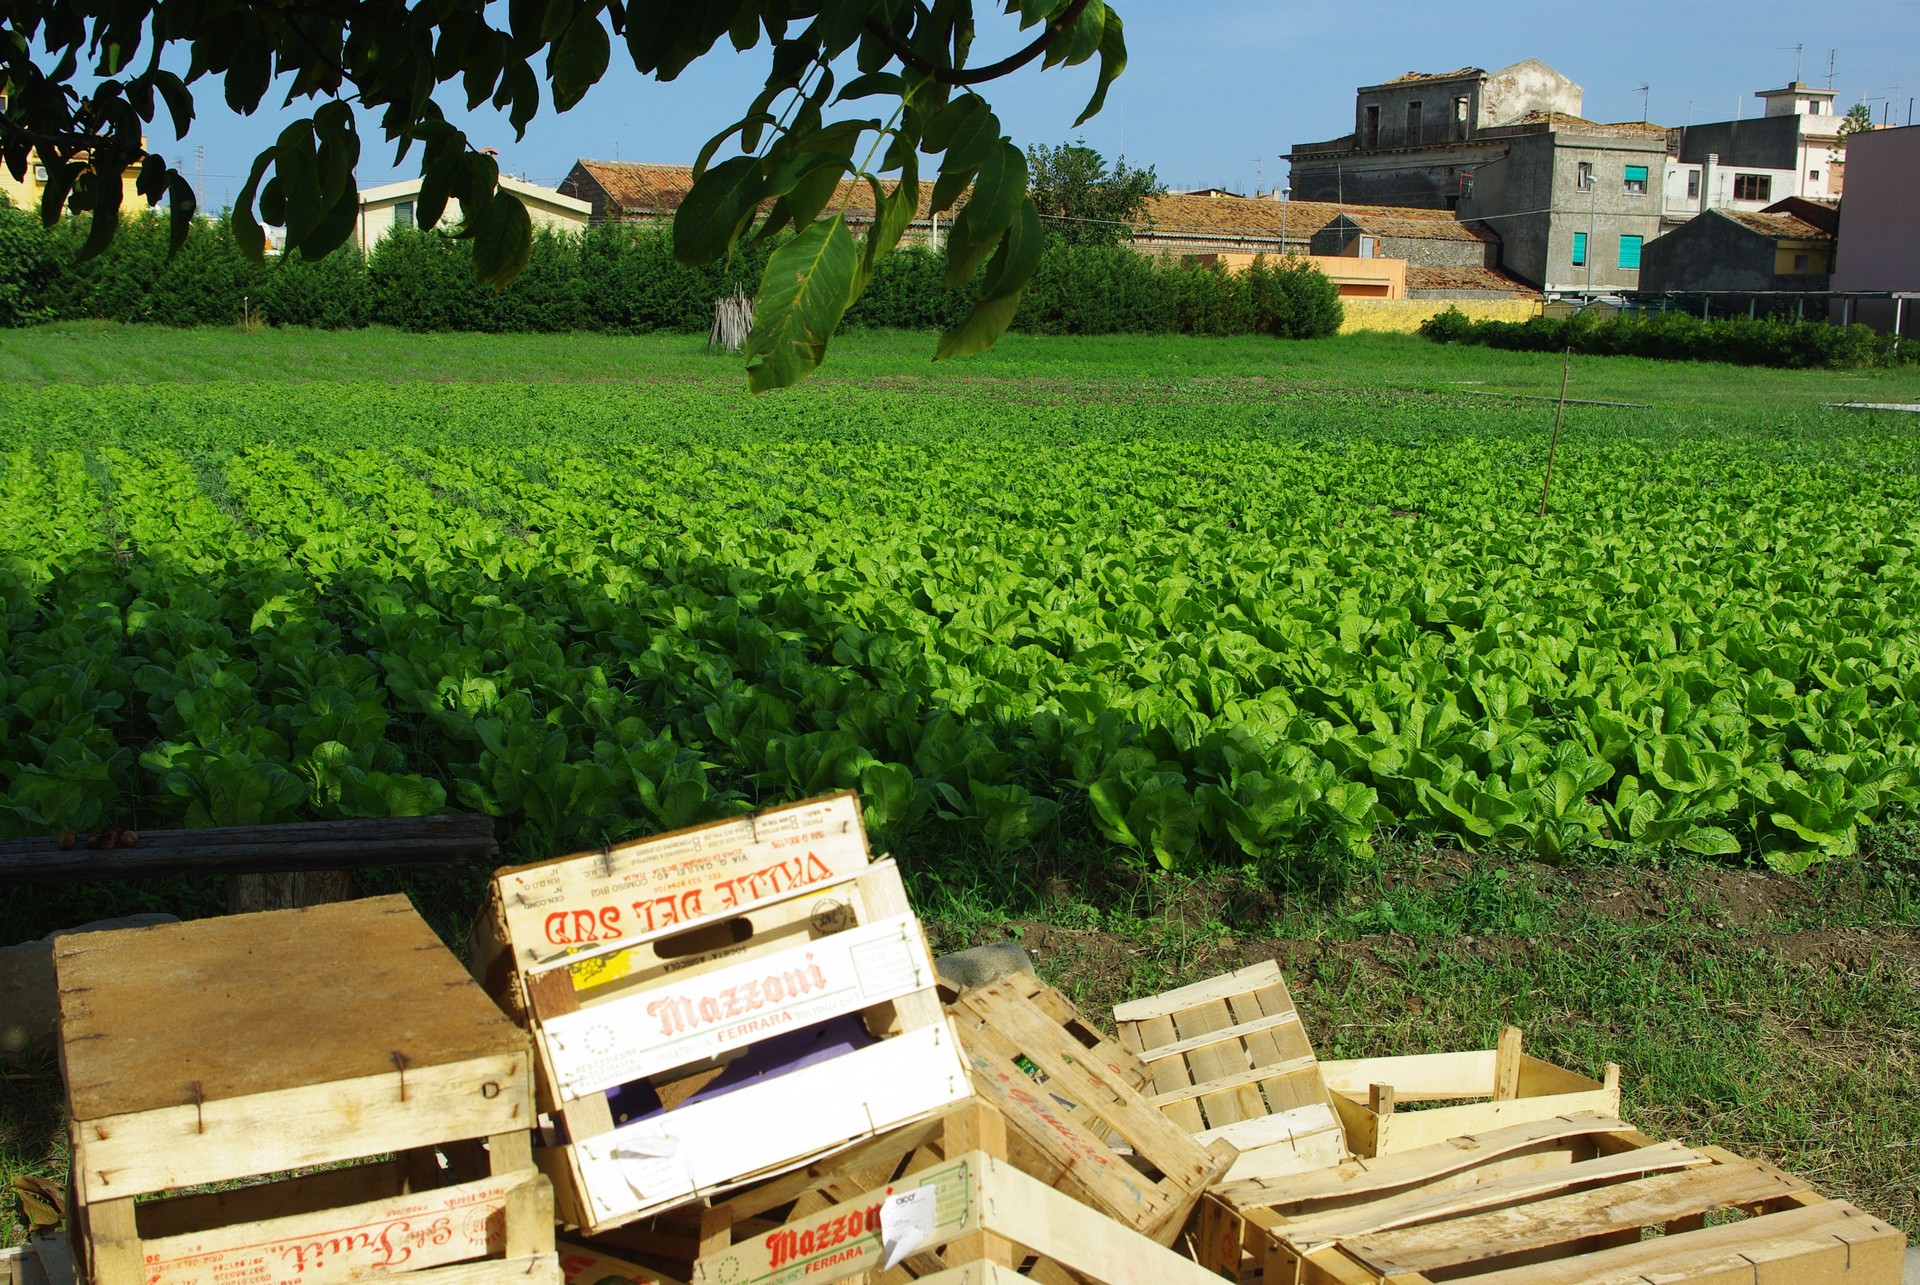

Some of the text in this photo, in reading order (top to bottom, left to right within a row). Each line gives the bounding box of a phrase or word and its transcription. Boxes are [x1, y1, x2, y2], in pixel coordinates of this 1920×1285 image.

[732, 854, 748, 864] VIA
[544, 852, 834, 945] VALLE DEL SUD
[612, 879, 648, 893] COMISO
[662, 955, 706, 973] AGRICOLA
[646, 952, 828, 1038] Mazzoni
[716, 1011, 793, 1043] FERRARA
[765, 1187, 894, 1268] Mazzon
[281, 1221, 412, 1274] Fruit
[804, 1245, 863, 1274] FERRARA
